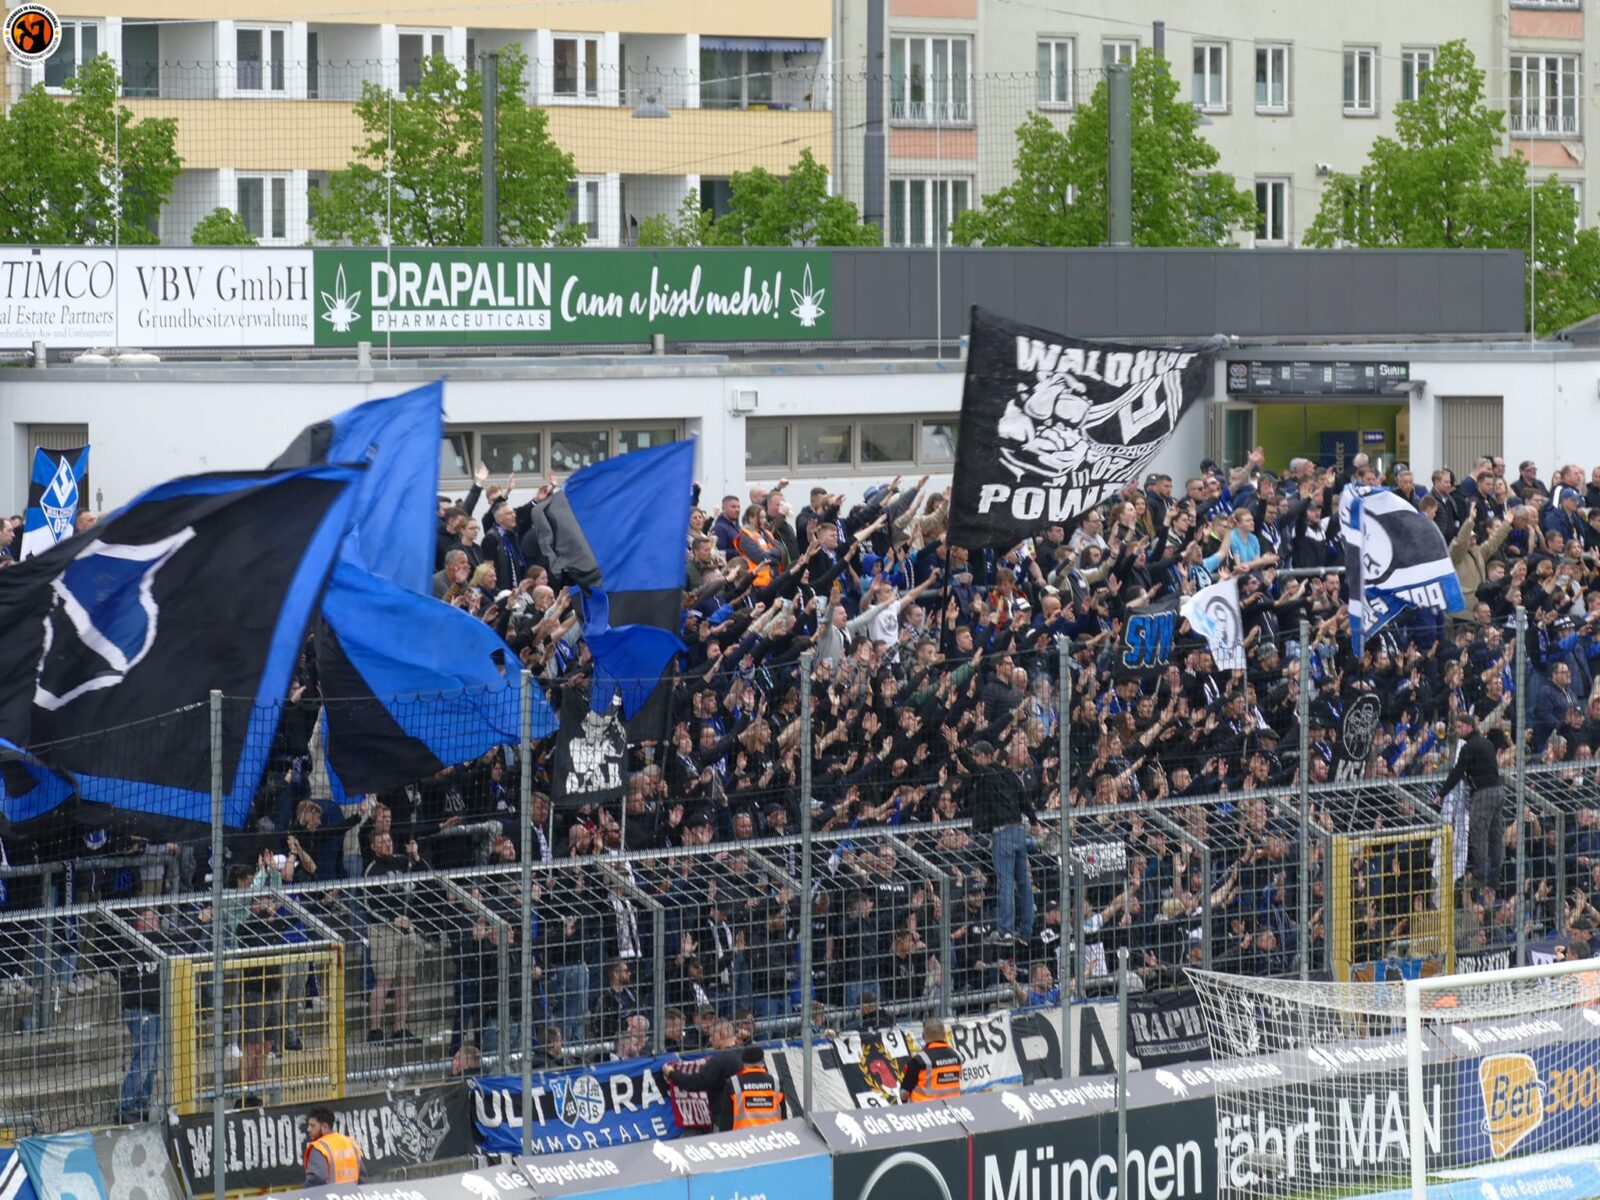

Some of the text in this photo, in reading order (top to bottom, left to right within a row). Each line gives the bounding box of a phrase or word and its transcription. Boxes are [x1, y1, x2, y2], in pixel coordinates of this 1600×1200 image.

[1, 260, 114, 299] TIMCO
[136, 265, 308, 302] VBV GmbH
[371, 262, 552, 307] DRAPALIN
[561, 275, 623, 322] Cann
[704, 265, 783, 320] mehr!
[16, 305, 56, 325] Estate
[60, 305, 114, 325] Partners
[137, 308, 309, 330] Grundbesitzverwaltung
[376, 312, 548, 328] PHARMACEUTICALS
[1182, 1060, 1283, 1086] die Bayerische
[1028, 1080, 1130, 1112] die Bayerisch
[864, 1104, 976, 1136] die Bayerische
[684, 1127, 801, 1163] die Bayerische
[498, 1156, 619, 1188] die Bayerische
[984, 1132, 1203, 1200] München
